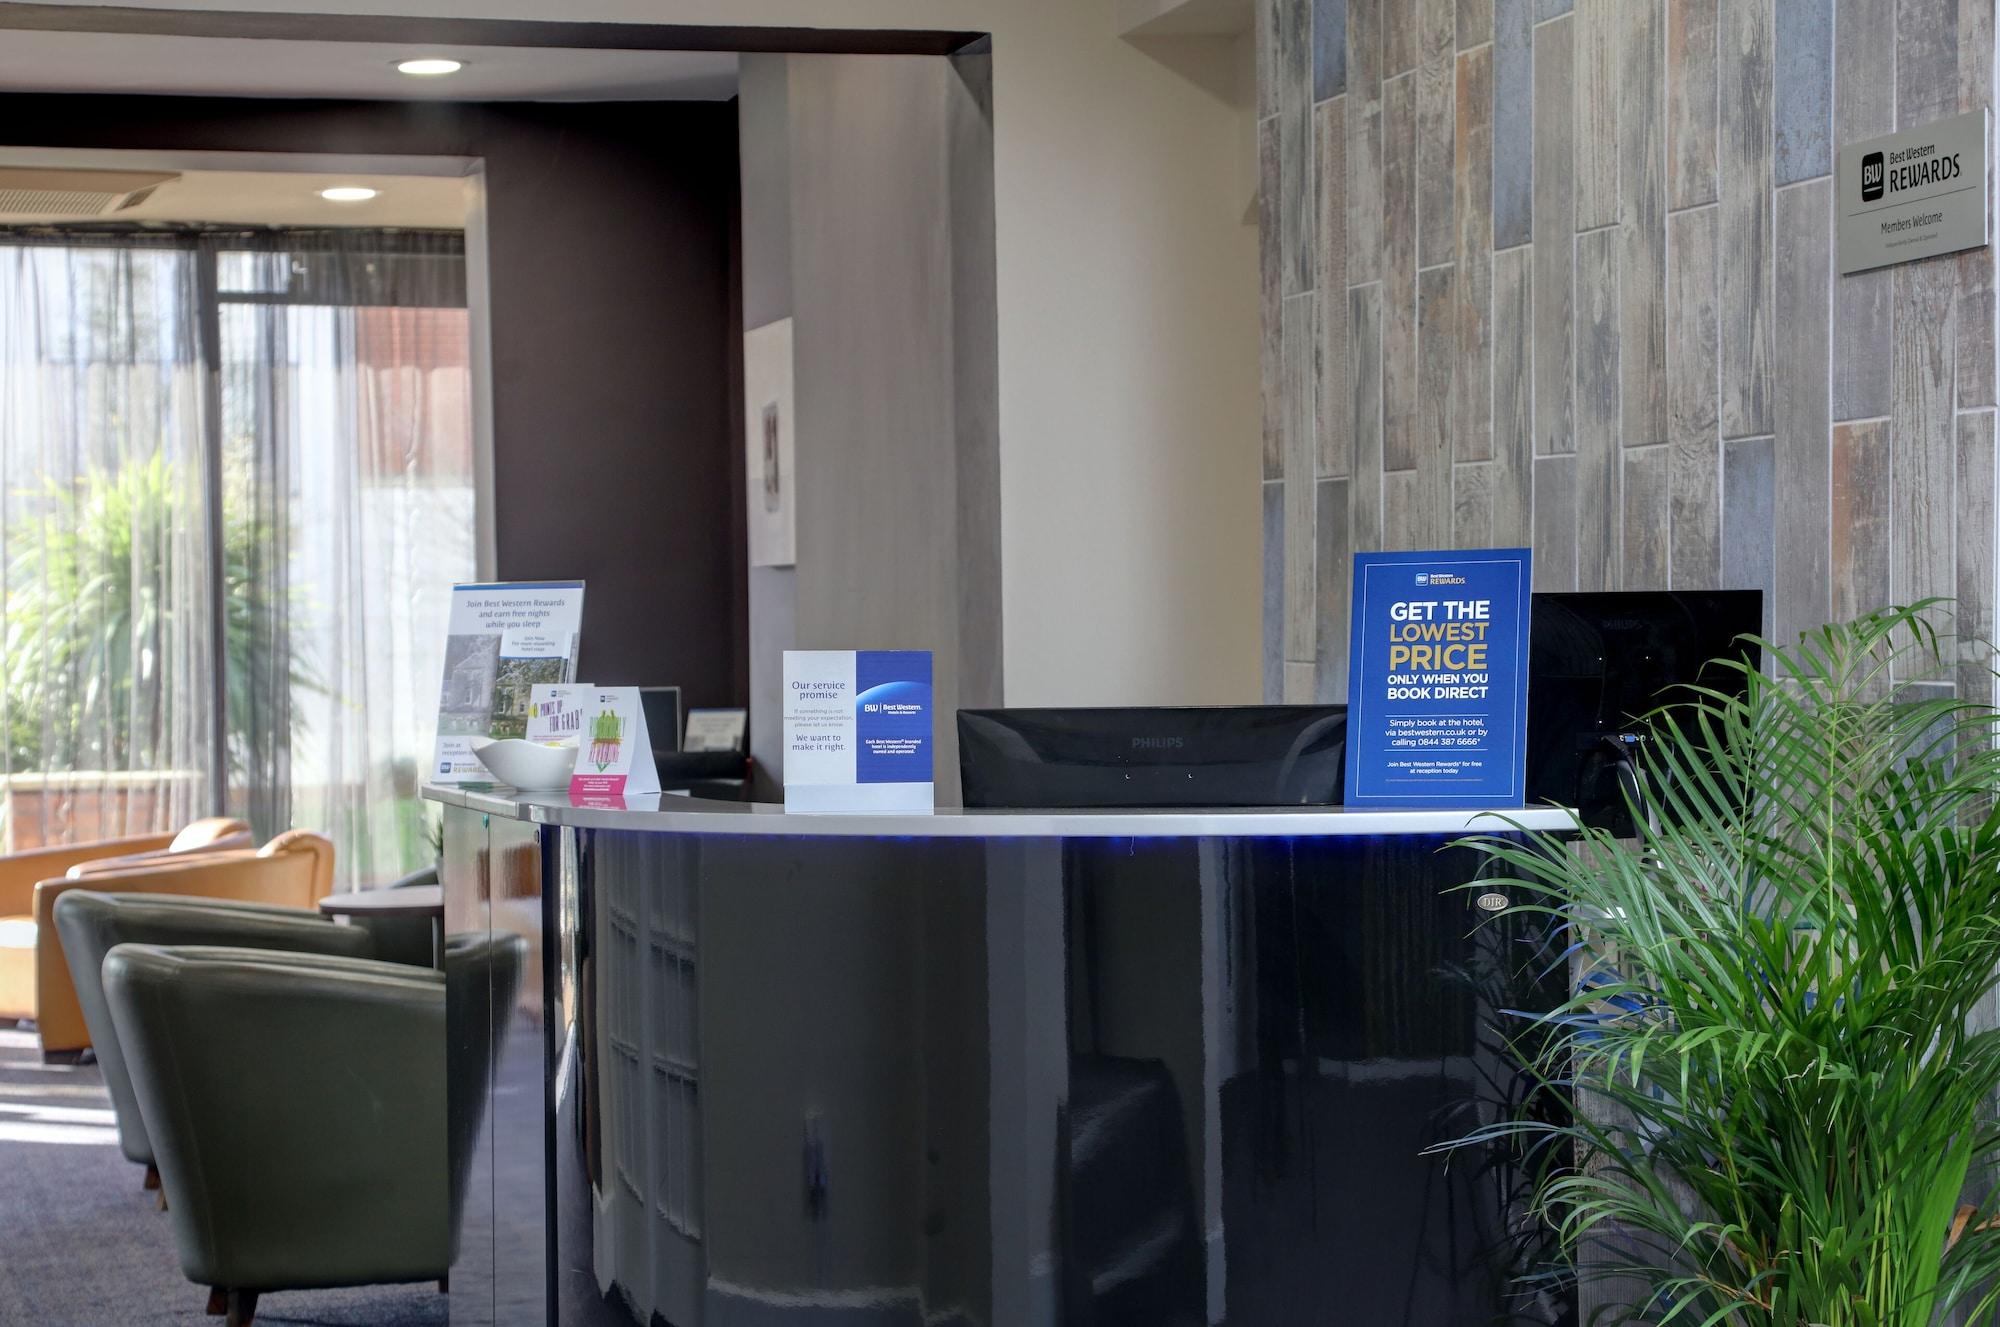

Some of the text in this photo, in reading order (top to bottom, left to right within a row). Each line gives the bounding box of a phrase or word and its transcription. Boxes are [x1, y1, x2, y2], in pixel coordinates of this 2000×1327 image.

[1890, 144, 1935, 165] Best Western
[1864, 163, 1882, 186] BW
[1890, 153, 1960, 193] REWARDS
[1881, 212, 1943, 235] Members Welcome
[1430, 577, 1465, 585] REWARDS
[465, 600, 482, 608] Join
[528, 609, 551, 619] nights
[1391, 600, 1490, 621] GET THE
[507, 622, 520, 630] you
[522, 621, 541, 630] sleep
[1390, 622, 1490, 642] LOWEST
[1390, 644, 1488, 671] PRICE
[1387, 673, 1489, 685] ONLY WHEN YOU
[792, 680, 845, 690] Our service
[799, 690, 838, 701] promise
[1387, 686, 1489, 700] BOOK DIRECT
[865, 704, 878, 712] BW
[1390, 718, 1484, 728] Simply book at the hotel,
[1385, 729, 1397, 737] via
[1398, 729, 1466, 737] bestwestern.co.uk
[1478, 728, 1488, 737] by
[793, 743, 846, 752] make it right.
[1132, 737, 1184, 749] PHILIPS
[1391, 738, 1416, 747] calling
[1418, 738, 1439, 746] 0844
[1441, 738, 1456, 746] 387
